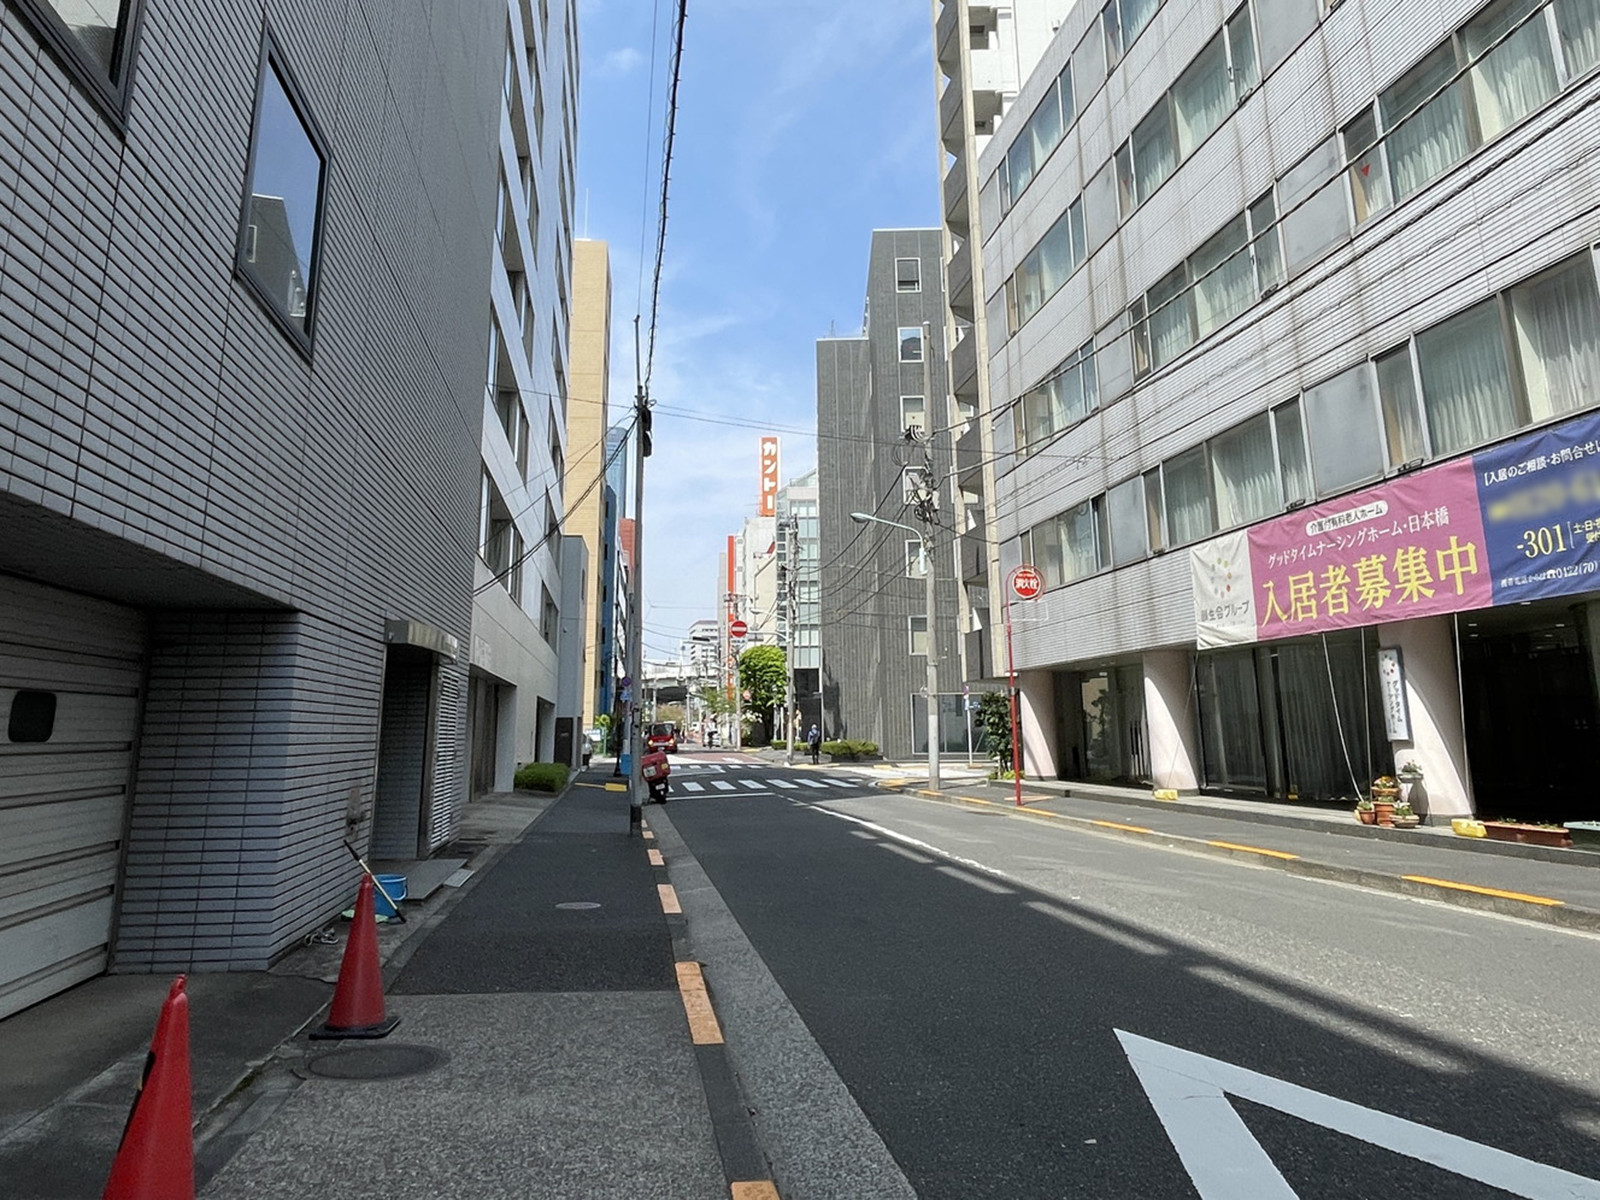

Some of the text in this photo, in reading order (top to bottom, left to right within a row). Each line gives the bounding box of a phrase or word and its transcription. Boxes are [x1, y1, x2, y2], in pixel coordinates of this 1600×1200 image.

[763, 441, 778, 510] カントー
[1268, 505, 1450, 570] グッドタイムナーシングホーム・日本橋
[1261, 535, 1479, 628] 入居者募集中
